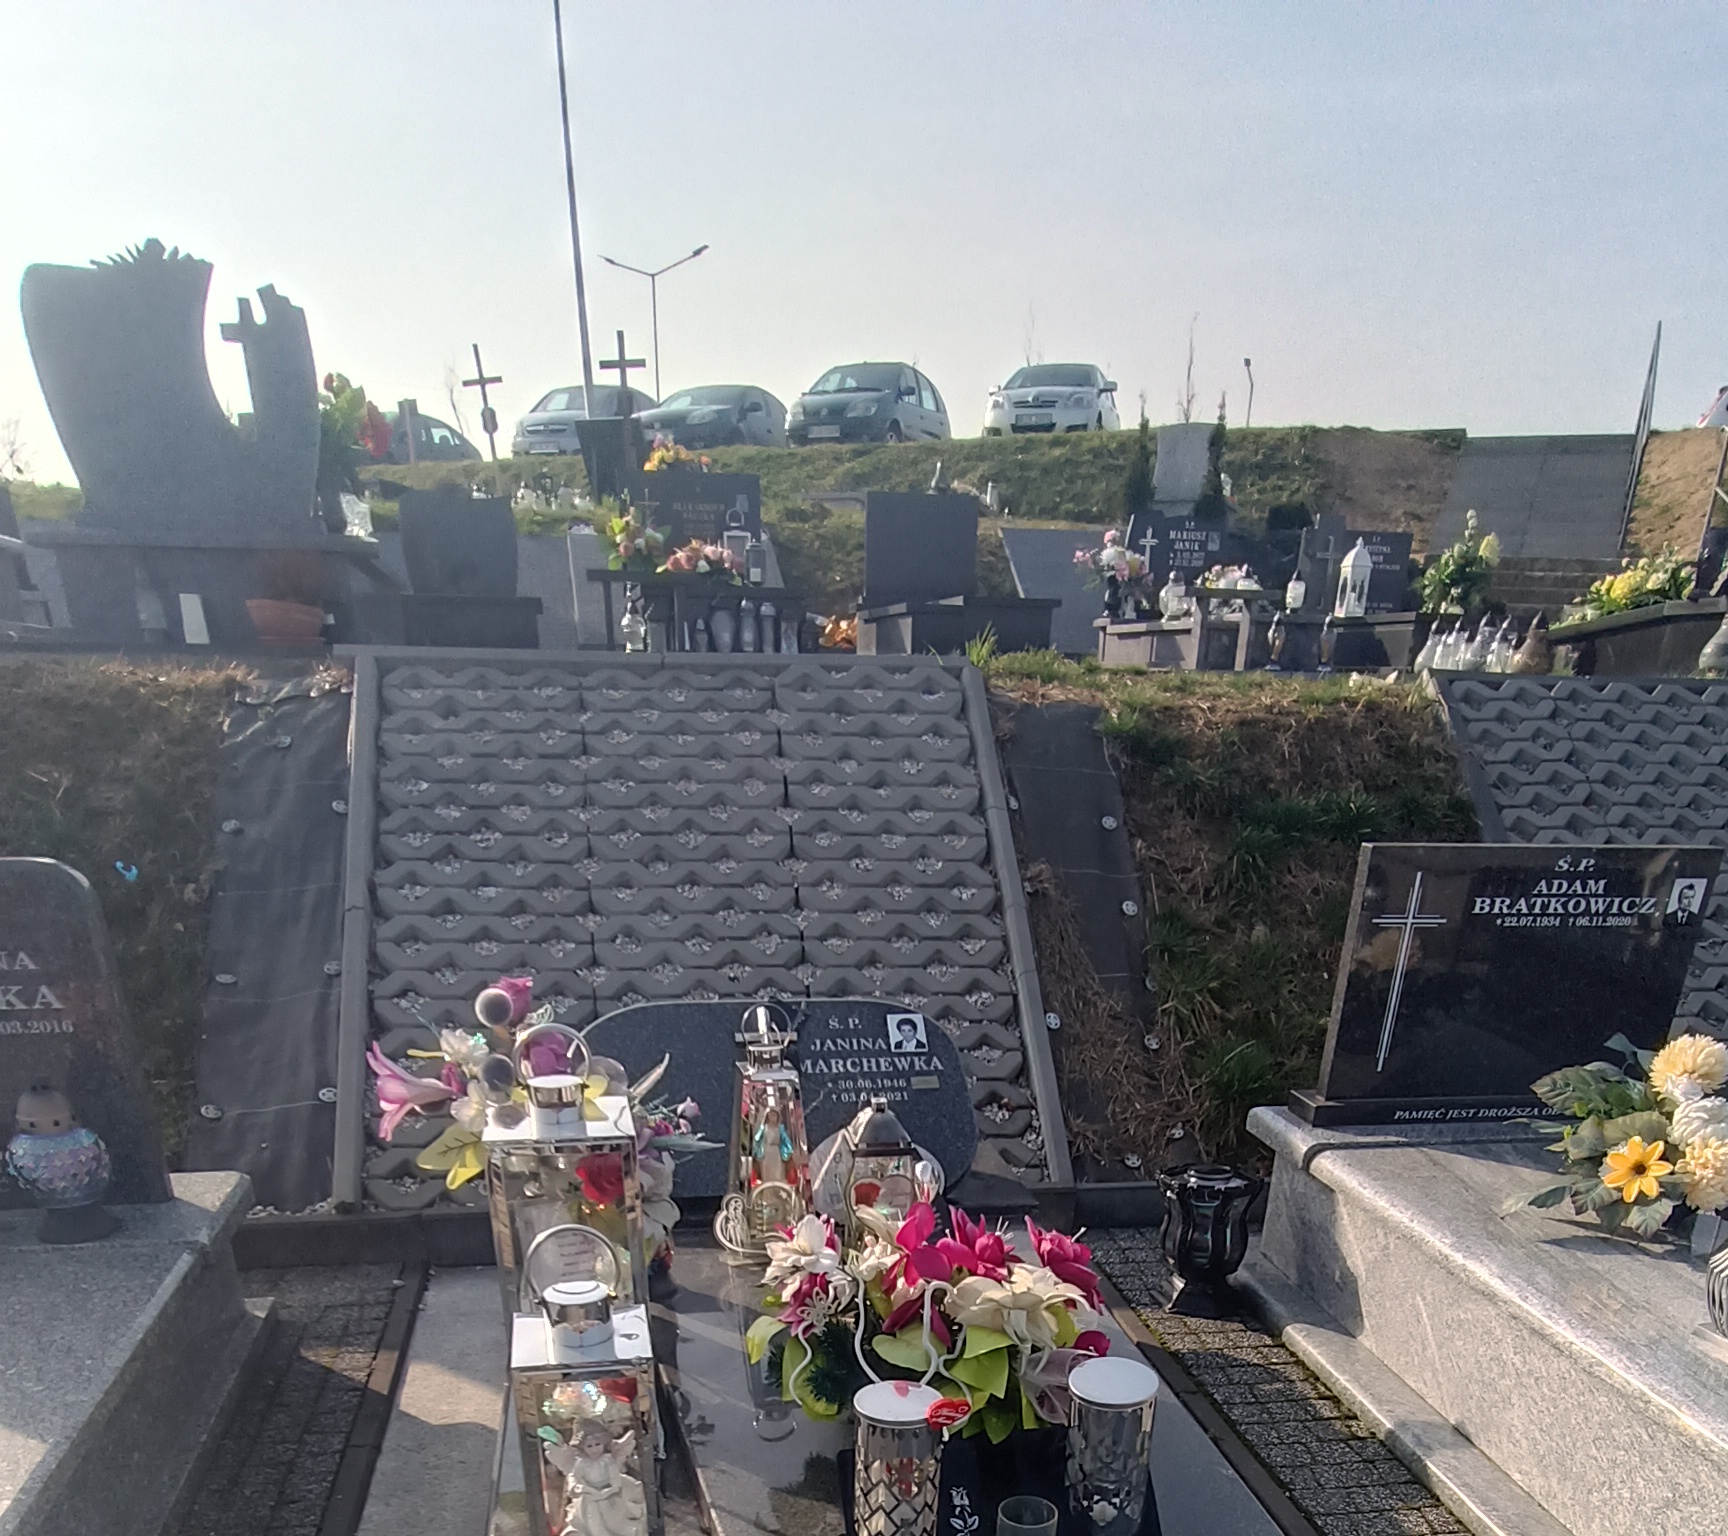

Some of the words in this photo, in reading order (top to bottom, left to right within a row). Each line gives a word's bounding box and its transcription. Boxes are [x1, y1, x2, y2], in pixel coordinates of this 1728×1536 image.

[1531, 878, 1608, 895] ADAM
[1471, 896, 1658, 915] BRATKOWICZ
[1502, 916, 1561, 928] 22.07.1934
[1575, 916, 1632, 927] 06.11.2020
[810, 1037, 888, 1051] JANINA
[799, 1056, 944, 1074] MARCHEWKA
[840, 1090, 909, 1103] 03.042021
[1393, 1106, 1446, 1121] PAMIĘĆ
[1446, 1108, 1476, 1120] JEST
[1477, 1106, 1539, 1118] DROŻSZA
